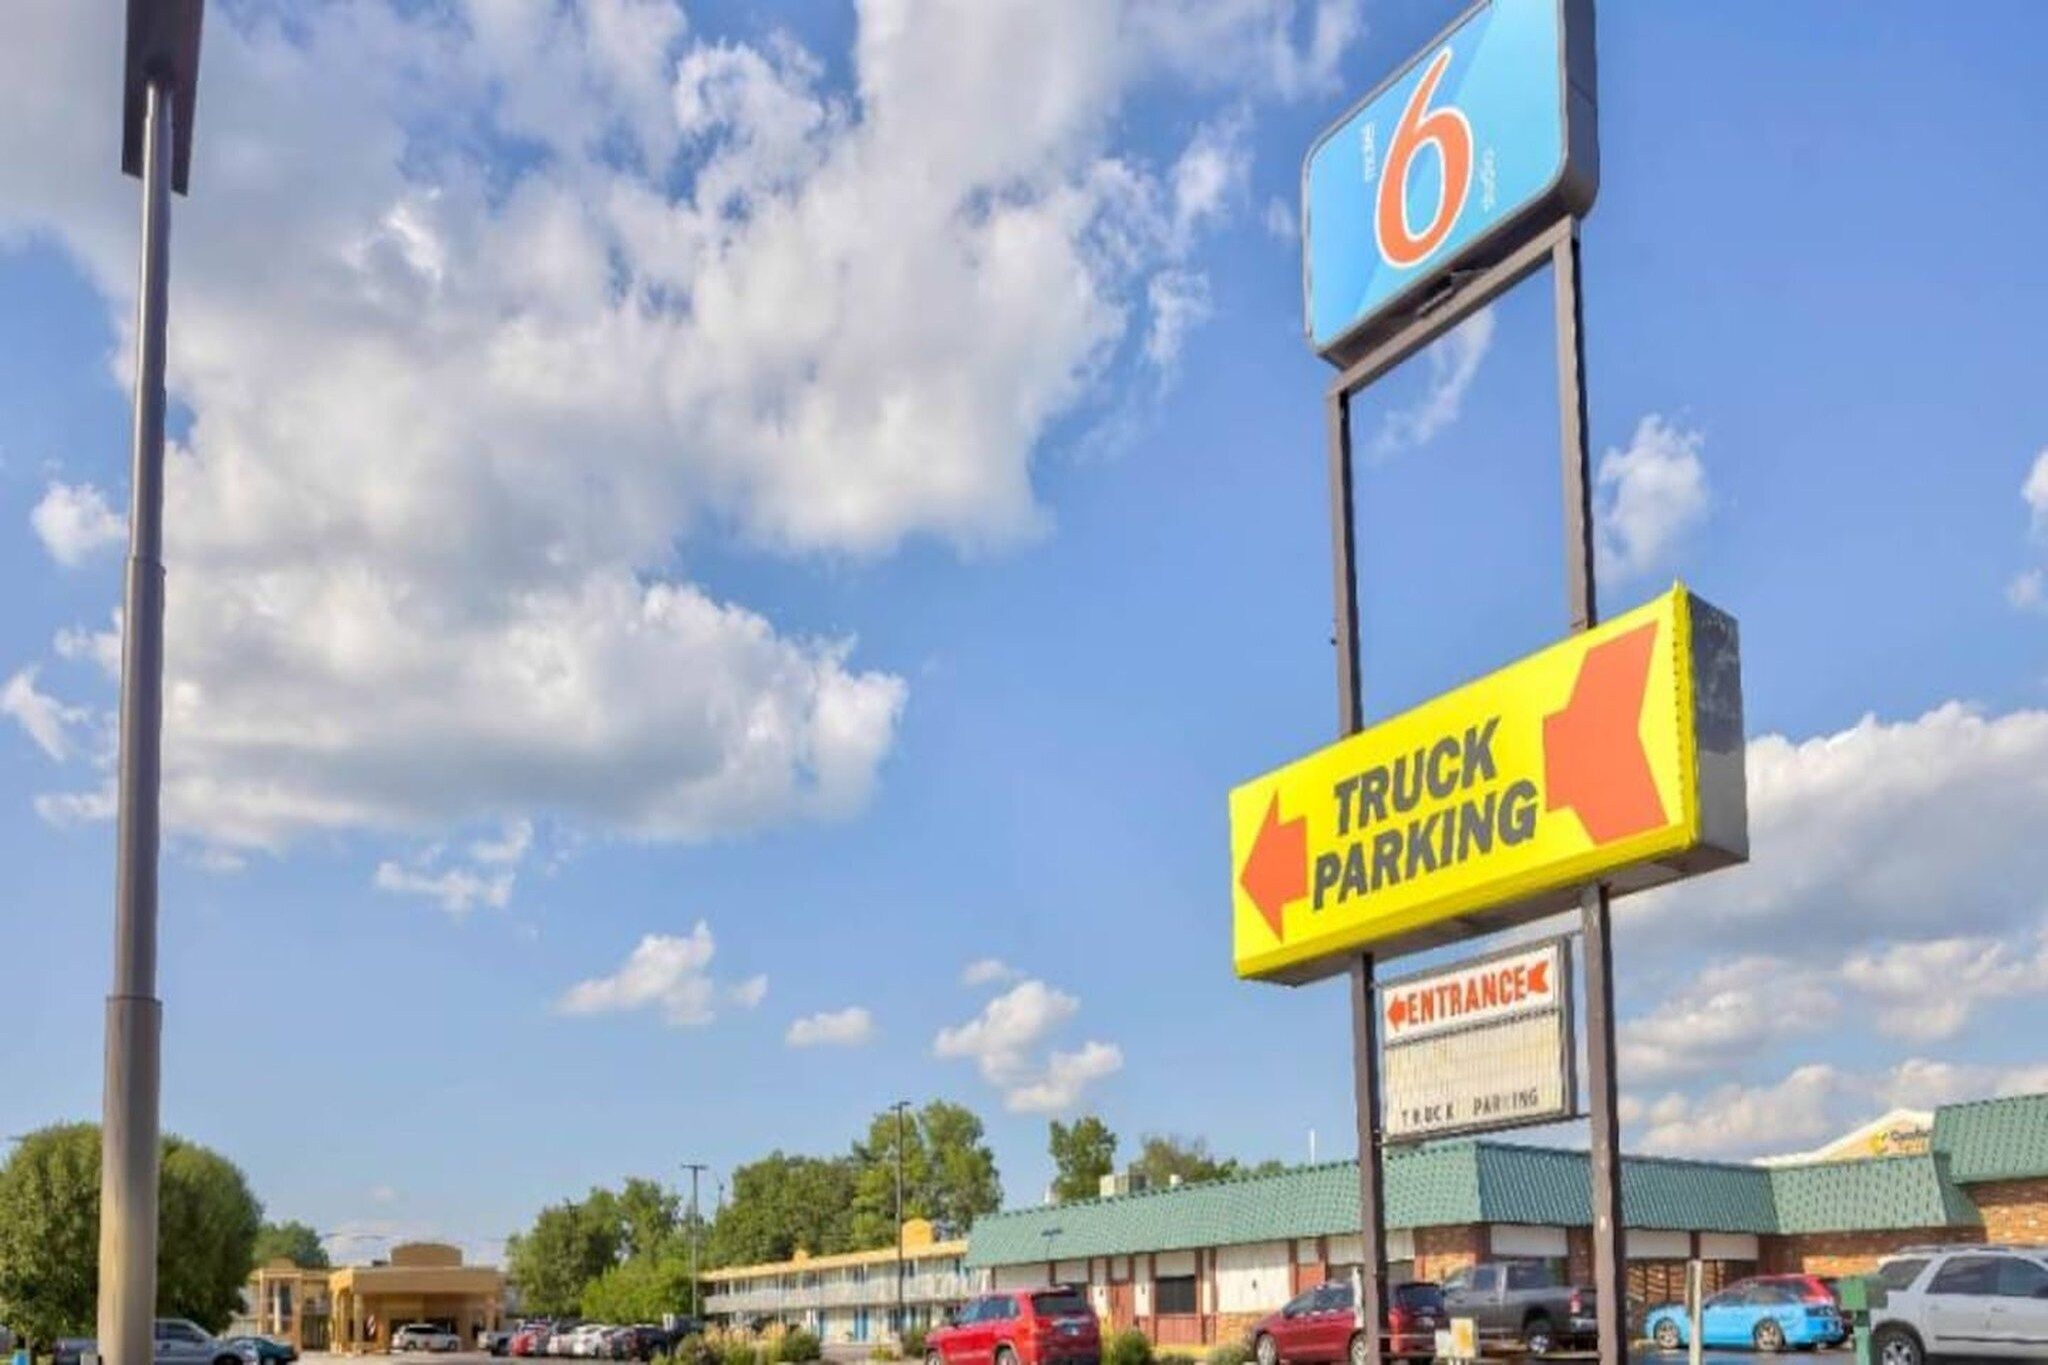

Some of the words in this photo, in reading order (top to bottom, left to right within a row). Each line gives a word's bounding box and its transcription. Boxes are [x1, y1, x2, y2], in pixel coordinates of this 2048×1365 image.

[1375, 46, 1474, 269] 6
[1334, 715, 1499, 837] TRUCK
[1313, 778, 1538, 911] PARKING
[1408, 966, 1527, 1025] ENTRANCE
[1402, 1104, 1454, 1126] TRUCK
